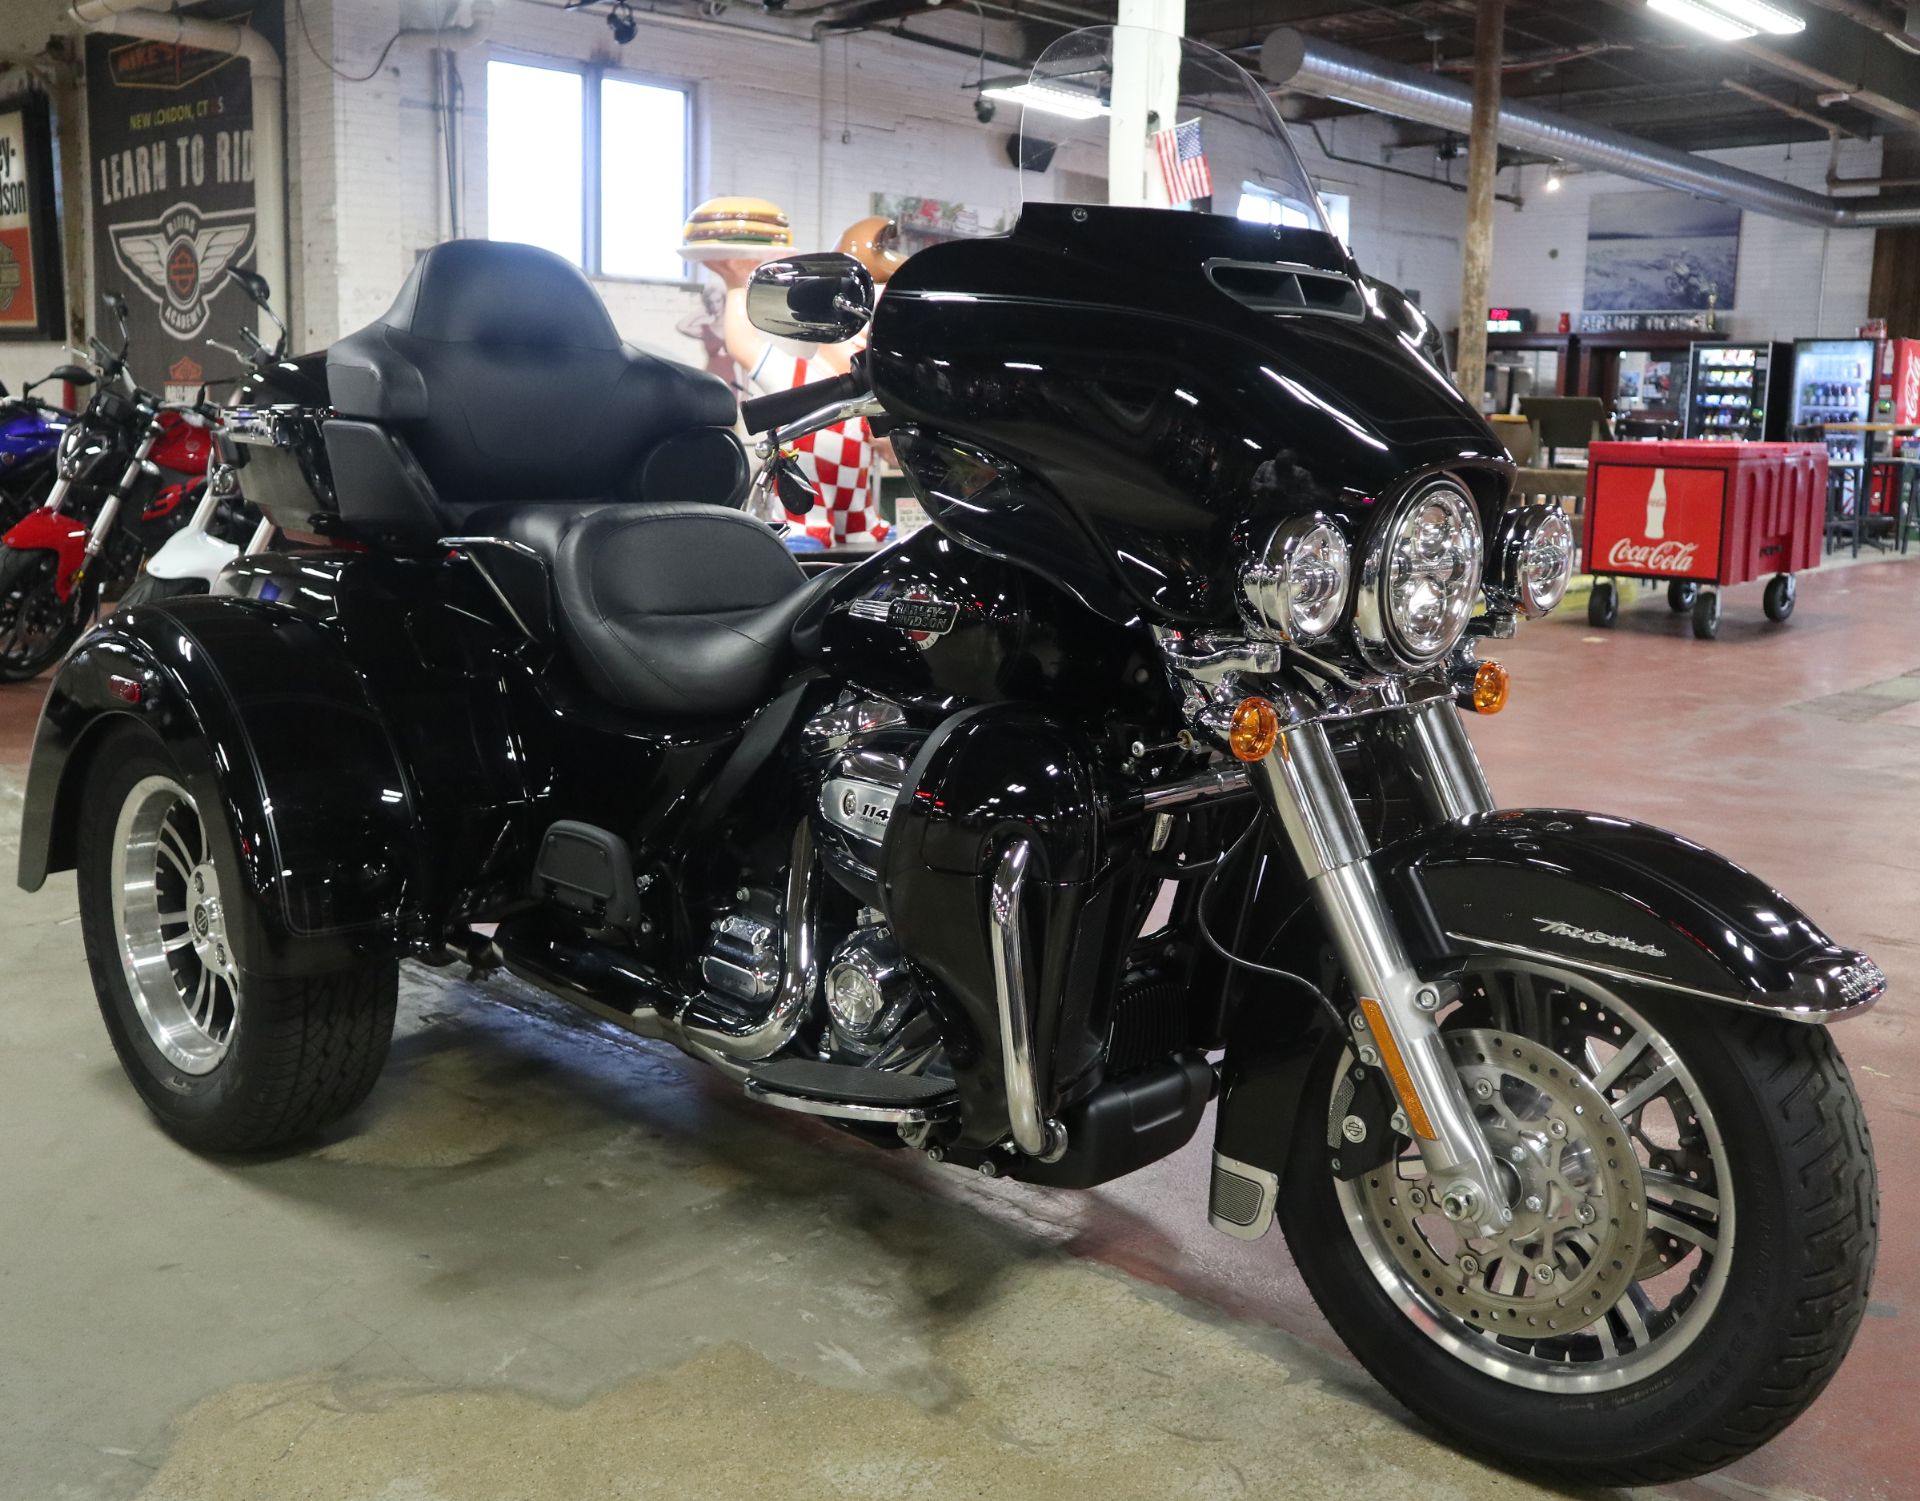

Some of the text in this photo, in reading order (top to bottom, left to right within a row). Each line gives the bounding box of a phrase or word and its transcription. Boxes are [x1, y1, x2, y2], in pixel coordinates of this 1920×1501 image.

[130, 112, 152, 129] NEW
[196, 99, 209, 117] CT
[101, 130, 255, 206] LEARN TO RID
[164, 305, 202, 330] ACADEMY
[1608, 538, 1699, 573] Coca-Cola
[862, 804, 890, 821] 114
